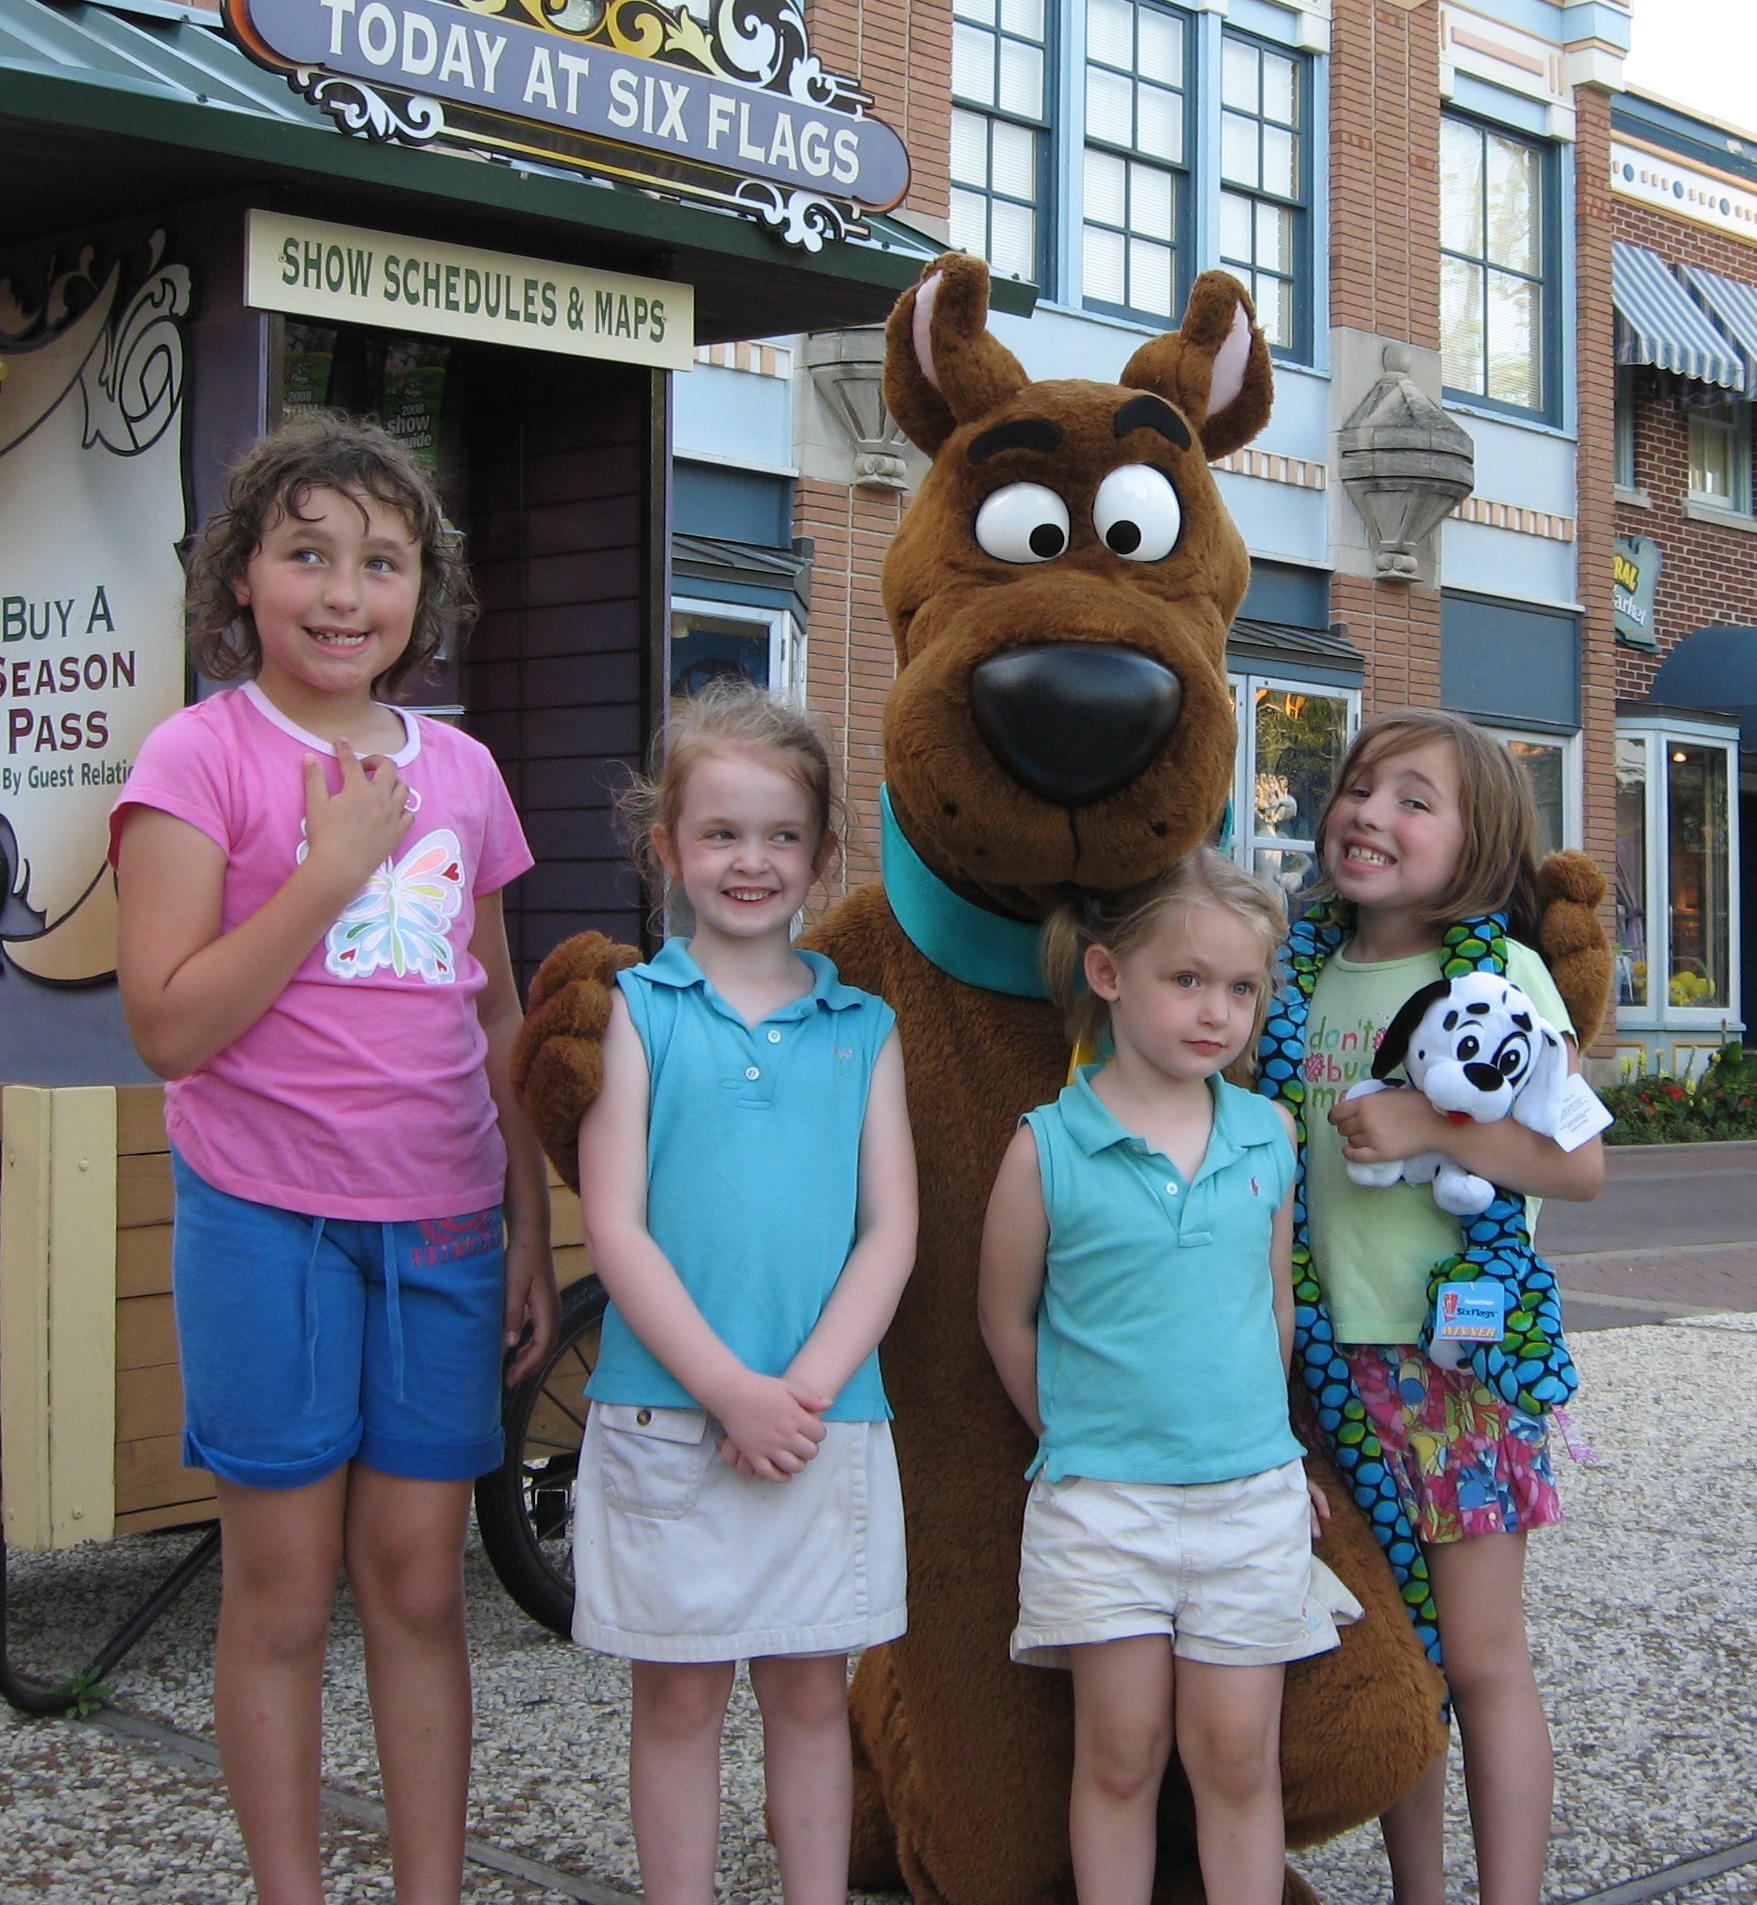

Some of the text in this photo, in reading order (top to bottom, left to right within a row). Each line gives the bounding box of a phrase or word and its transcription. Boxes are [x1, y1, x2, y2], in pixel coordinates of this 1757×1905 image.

[320, 0, 860, 185] TODAY AT SIX FLAGS
[281, 237, 666, 343] SHOW SCHEDULES & MAPS
[387, 415, 431, 434] show
[86, 585, 115, 634] A
[1613, 584, 1646, 626] arket
[2, 767, 22, 796] By
[28, 765, 74, 788] Guest
[1309, 1015, 1375, 1051] don't
